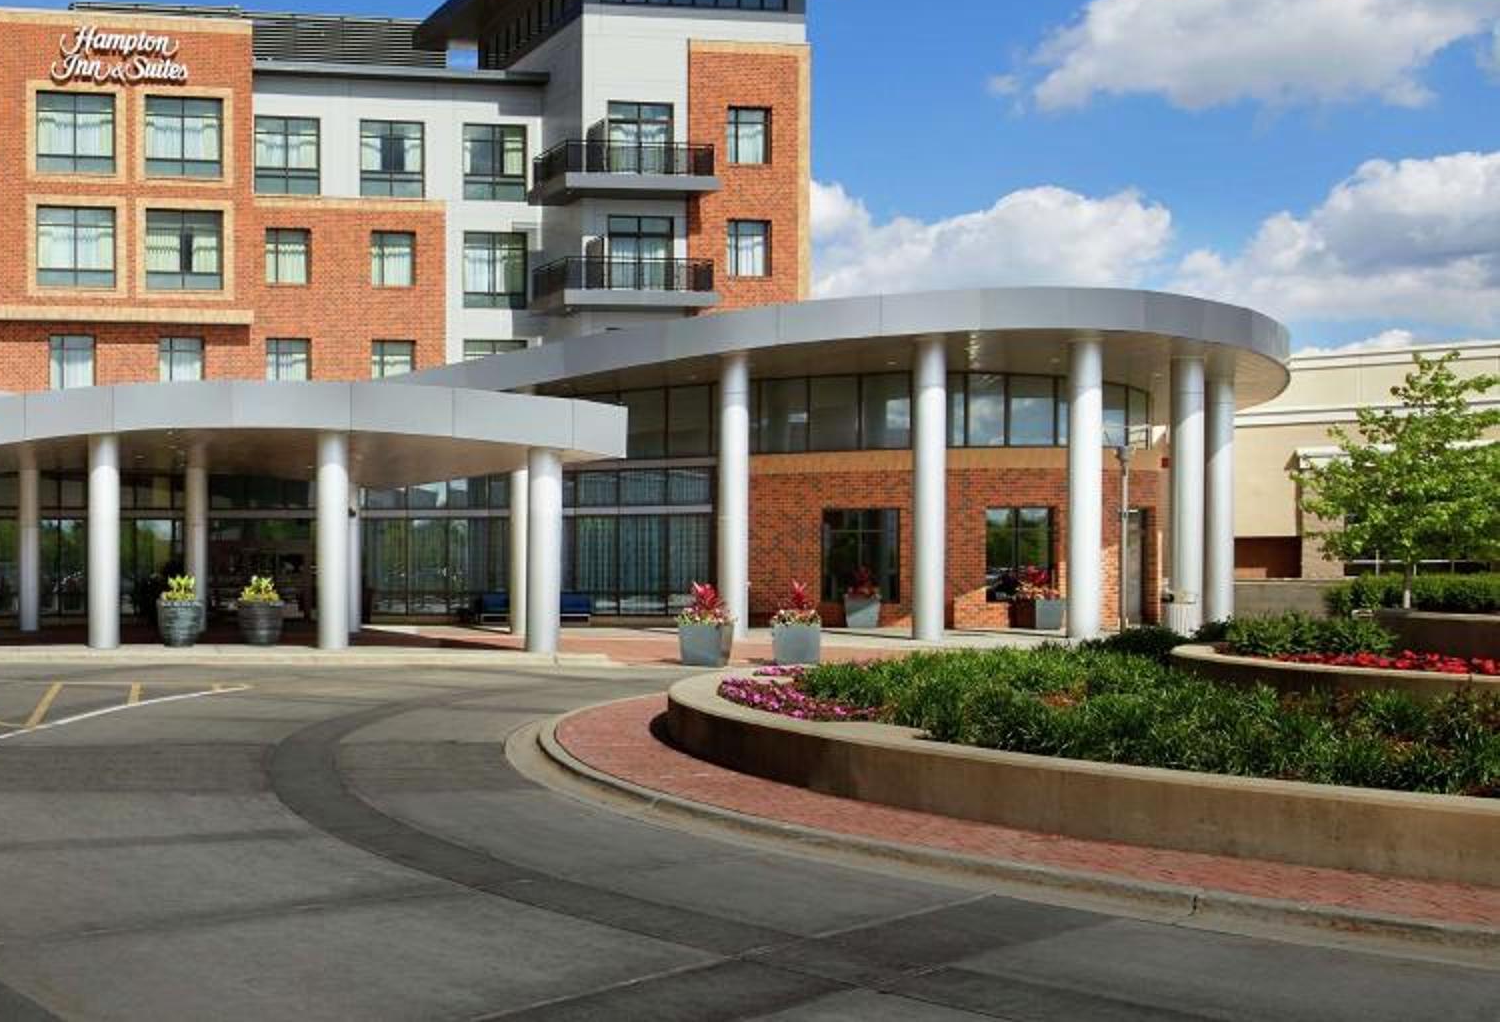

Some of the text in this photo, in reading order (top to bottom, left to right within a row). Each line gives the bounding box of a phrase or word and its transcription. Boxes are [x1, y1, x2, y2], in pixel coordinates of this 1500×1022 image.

[60, 25, 179, 57] Hampton
[51, 54, 111, 80] Inn
[125, 56, 188, 81] Suites
